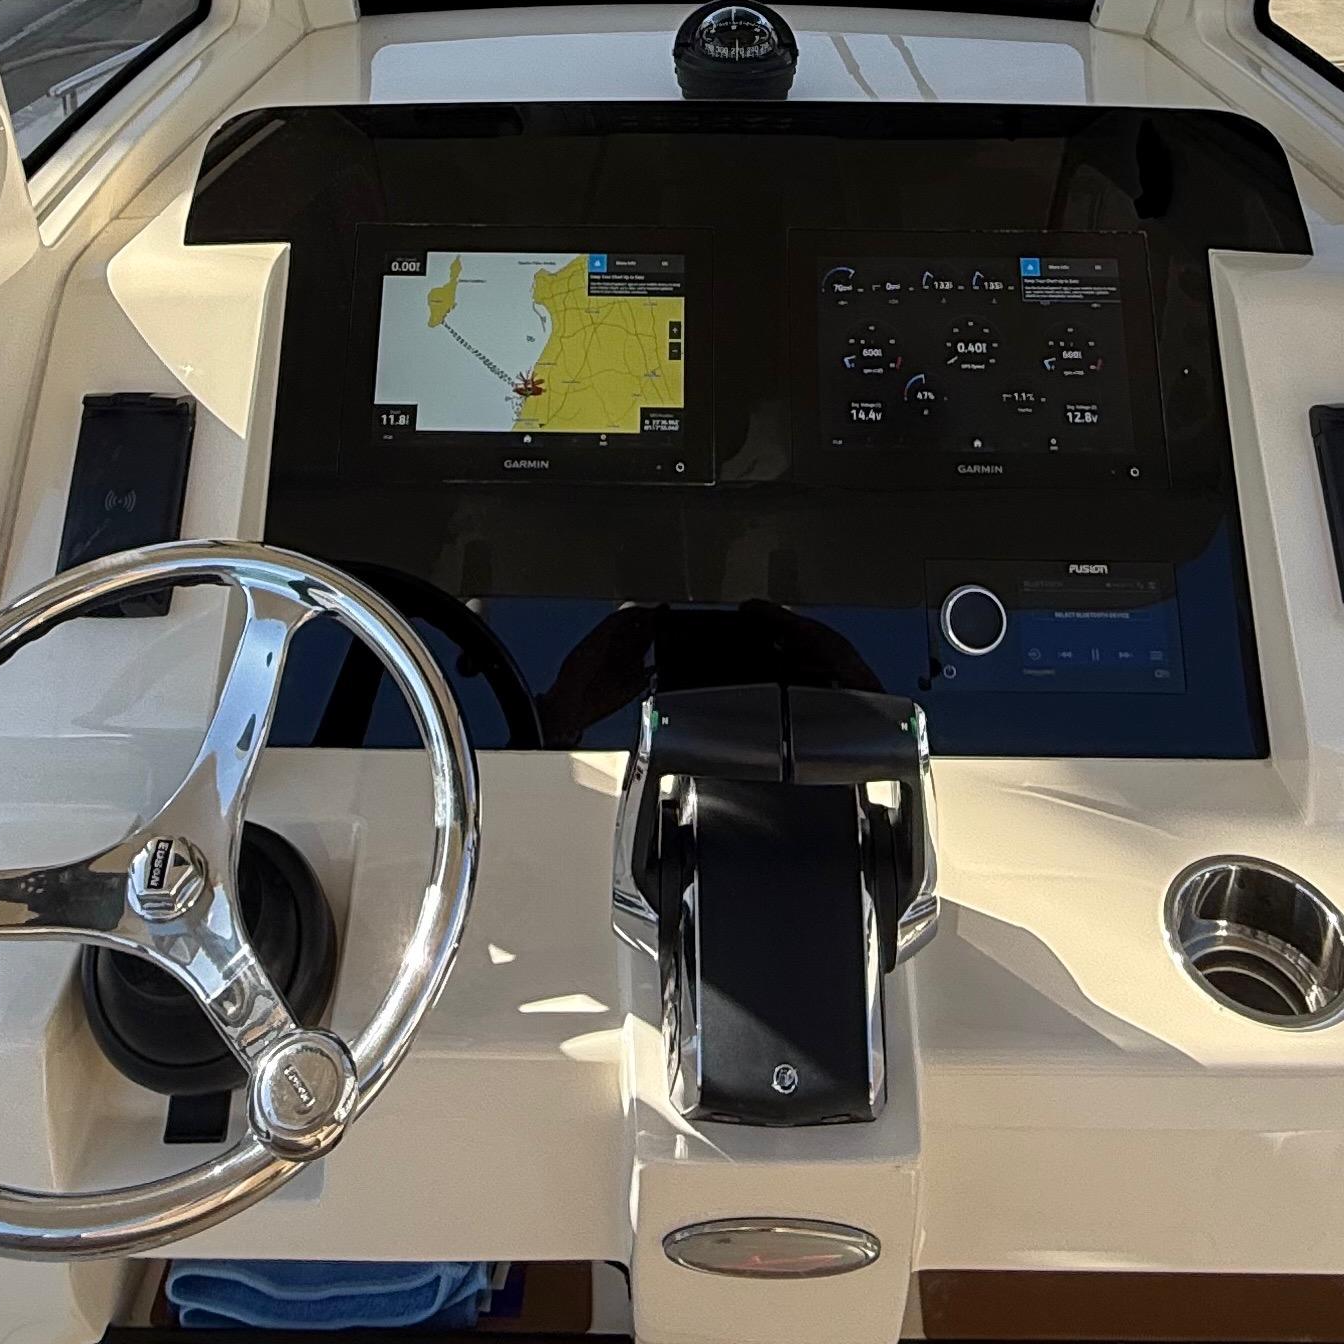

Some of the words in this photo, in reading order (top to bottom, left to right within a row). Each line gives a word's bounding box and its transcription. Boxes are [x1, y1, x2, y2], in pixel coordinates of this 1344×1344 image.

[503, 459, 550, 470] GARMIN
[956, 464, 1004, 475] GARMIN
[150, 842, 169, 887] EDSON
